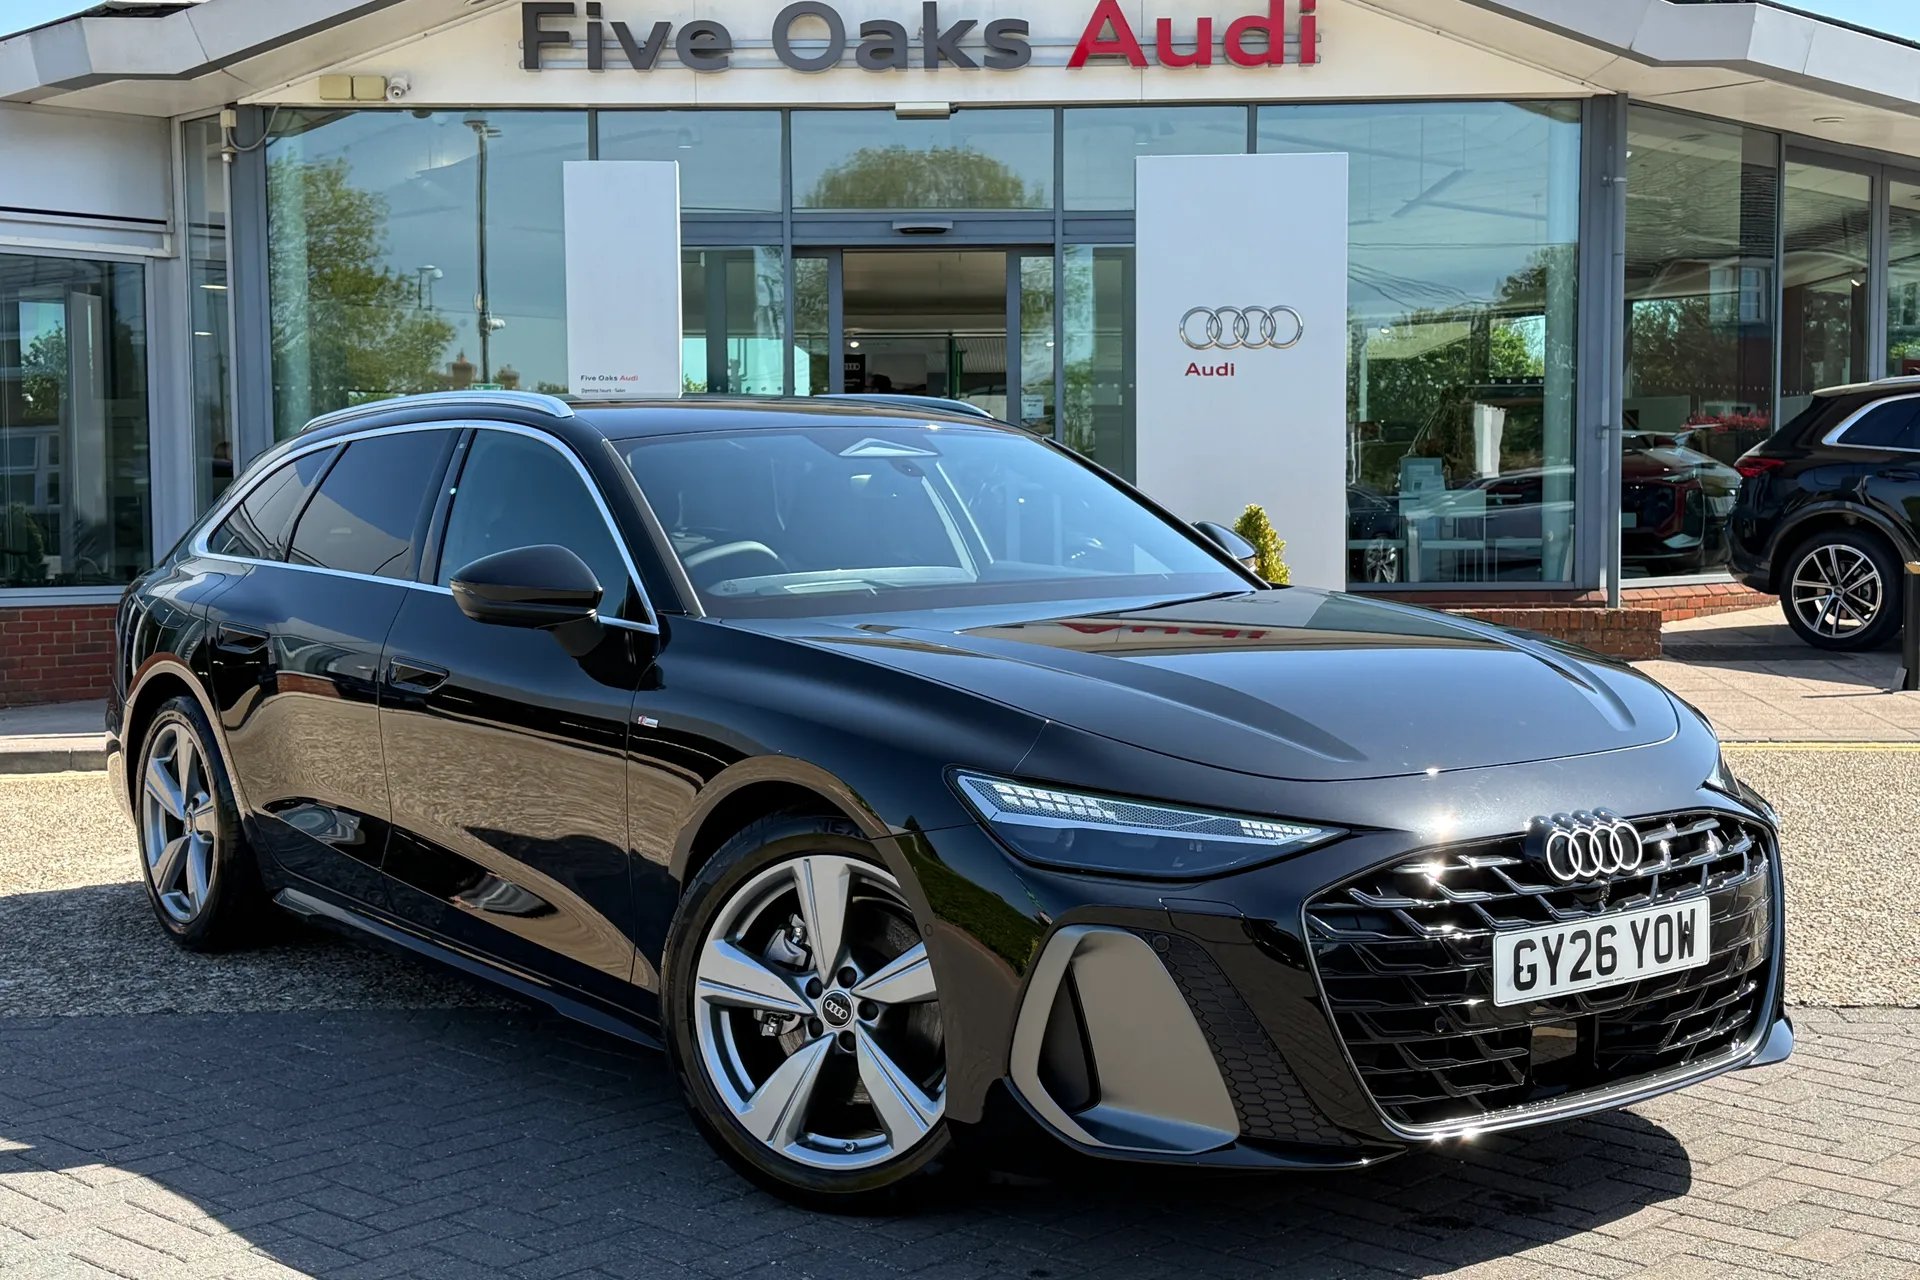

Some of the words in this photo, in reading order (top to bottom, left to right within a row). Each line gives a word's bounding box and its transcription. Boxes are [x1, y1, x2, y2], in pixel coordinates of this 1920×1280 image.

[522, 2, 733, 72] Five
[772, 1, 1032, 73] Oaks
[1066, 0, 1317, 69] Audi
[1184, 362, 1235, 377] Audi
[1513, 925, 1618, 991] GY26
[1630, 908, 1696, 969] YOW
